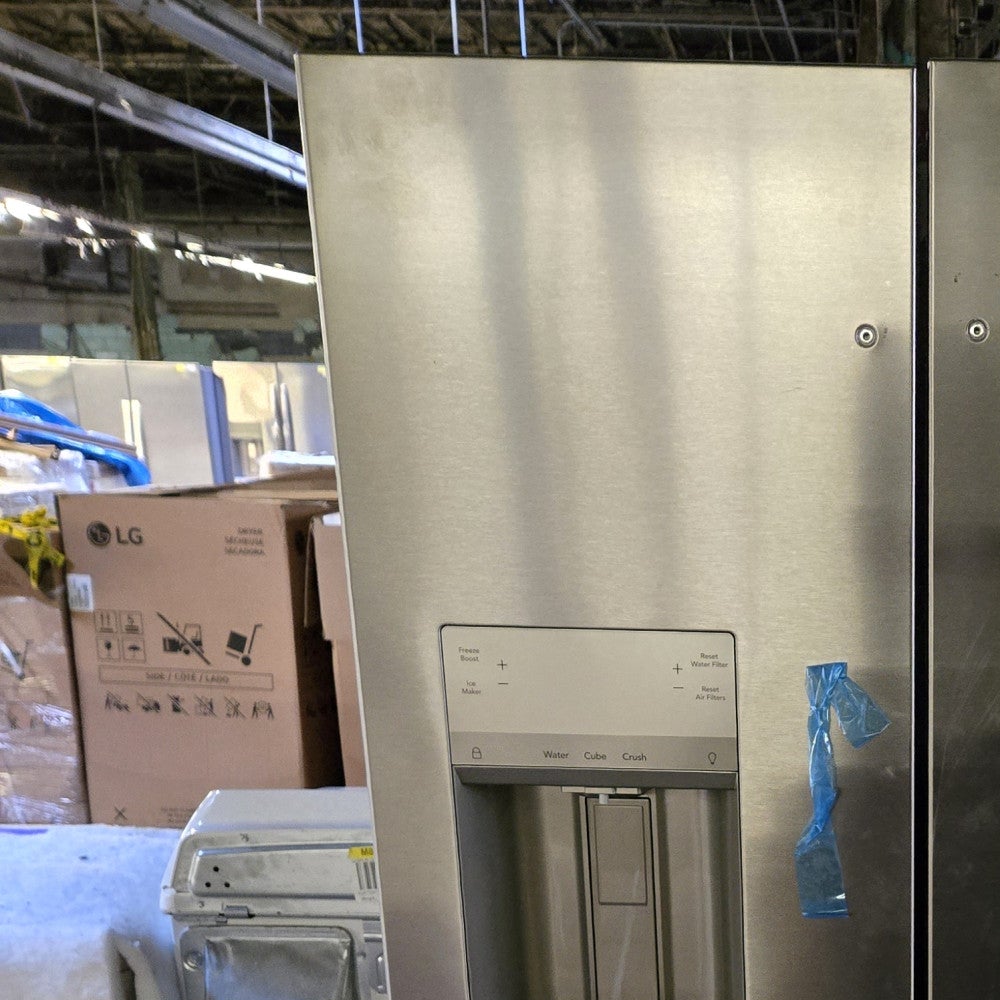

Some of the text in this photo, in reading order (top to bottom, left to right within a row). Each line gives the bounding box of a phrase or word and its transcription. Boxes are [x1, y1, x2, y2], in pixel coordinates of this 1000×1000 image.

[115, 526, 144, 545] LG
[459, 646, 480, 654] Freeze
[701, 652, 719, 660] Reset
[543, 750, 647, 762] Water Cube Crush
